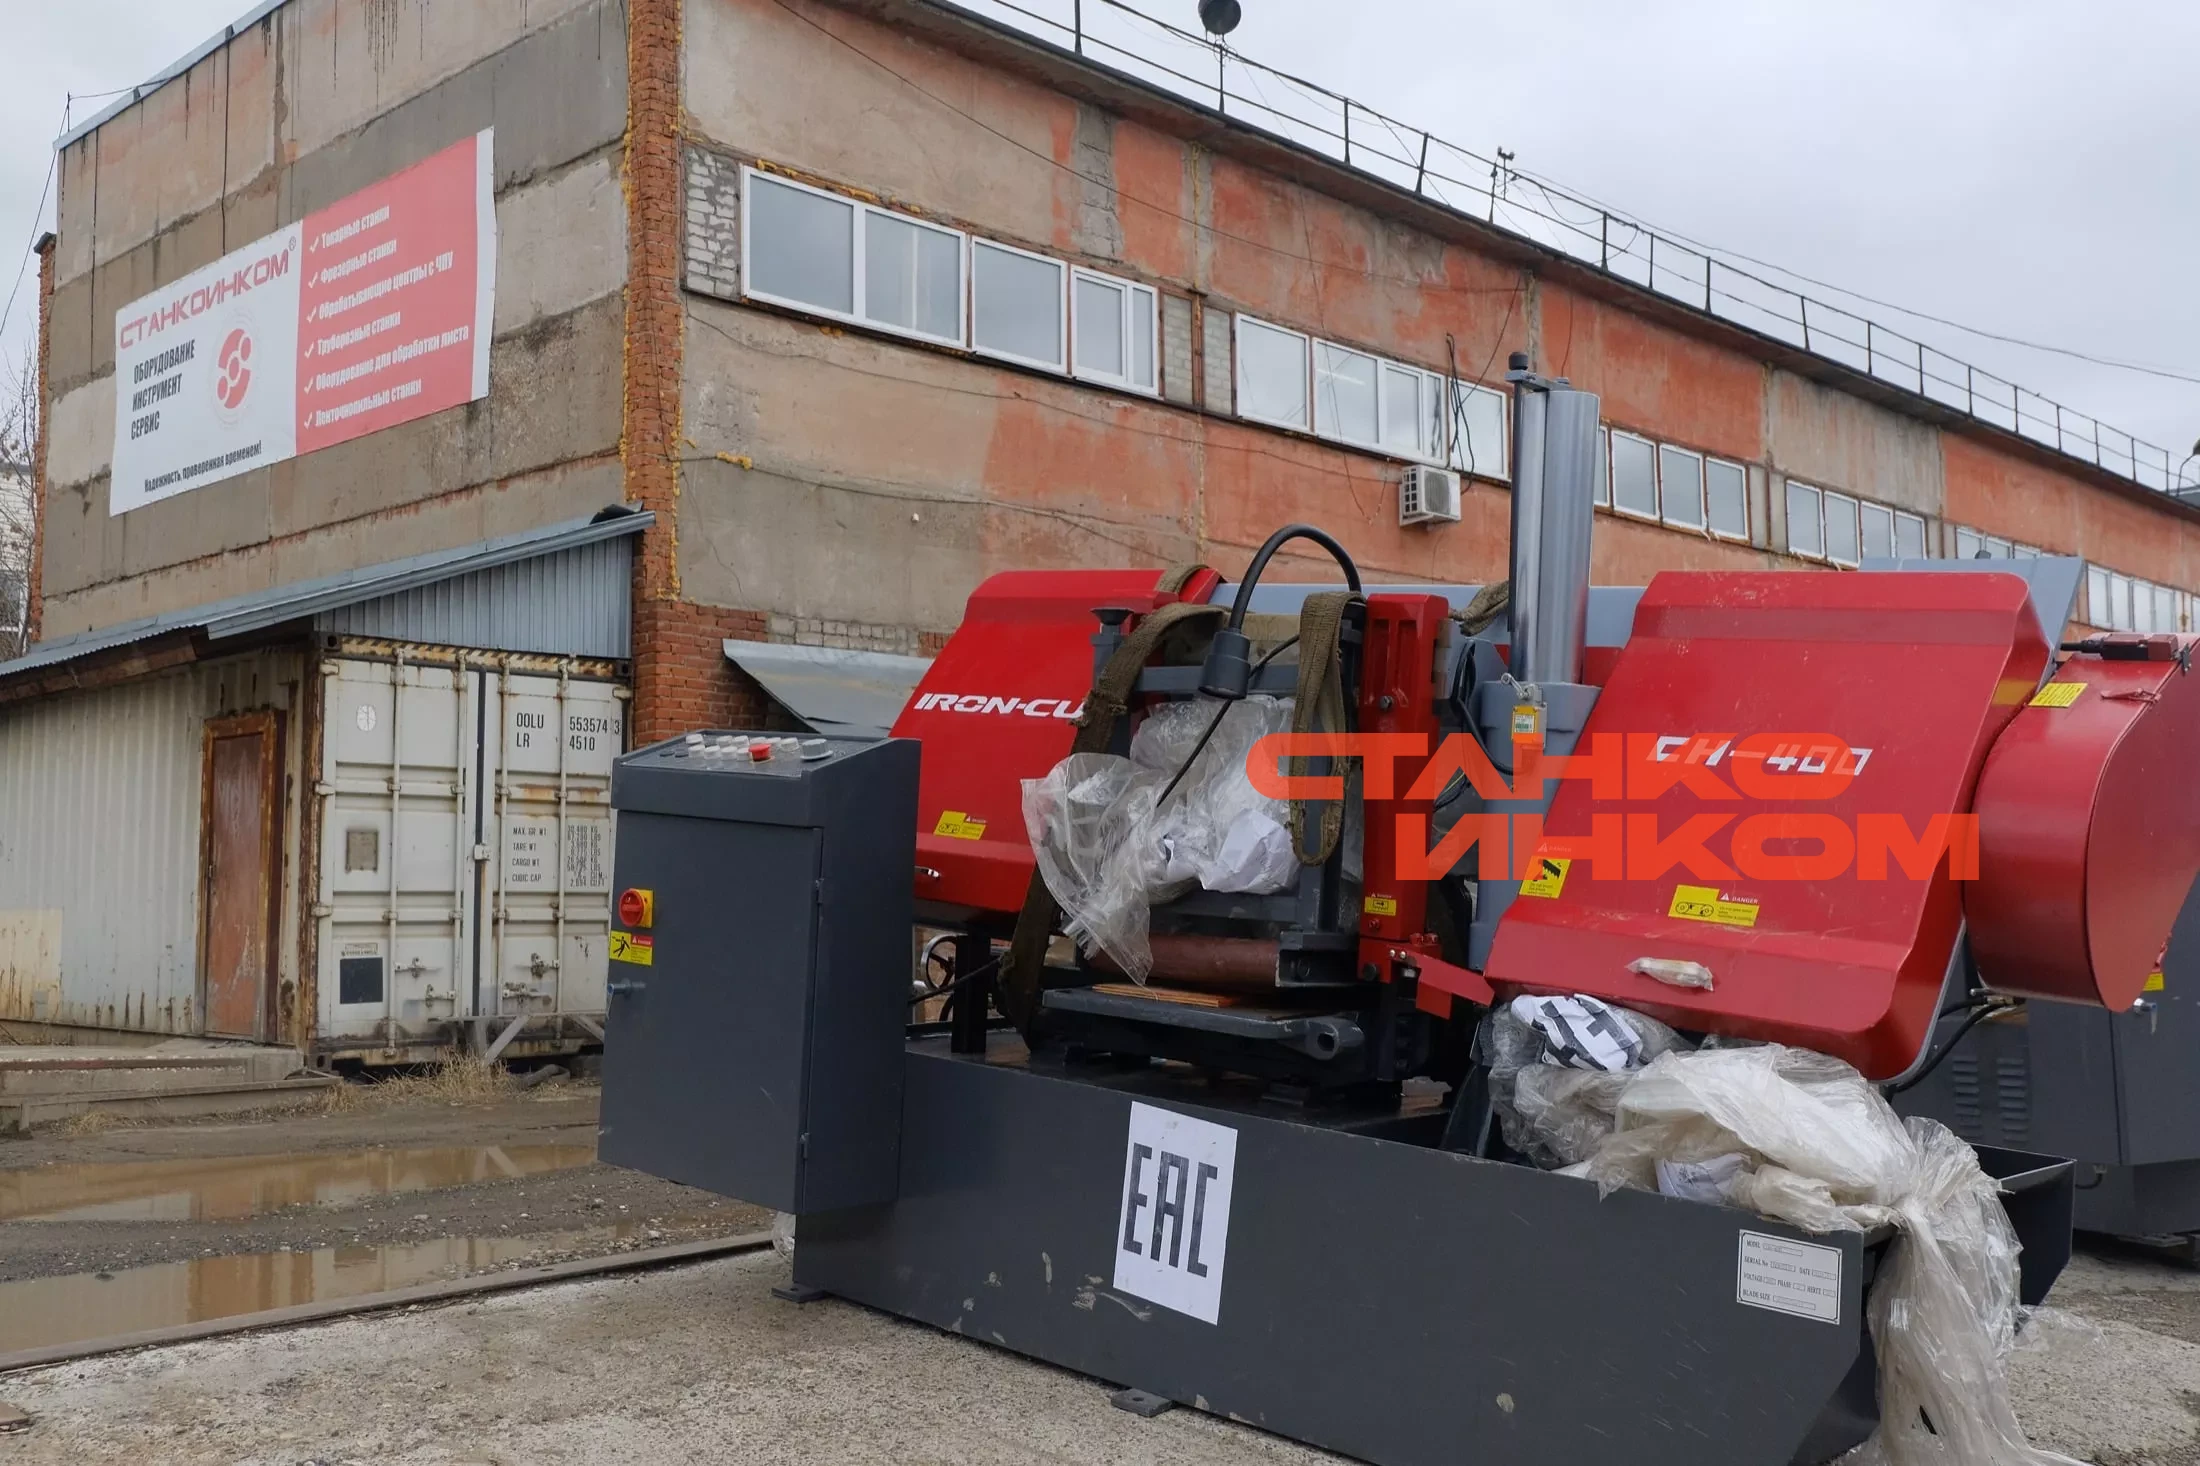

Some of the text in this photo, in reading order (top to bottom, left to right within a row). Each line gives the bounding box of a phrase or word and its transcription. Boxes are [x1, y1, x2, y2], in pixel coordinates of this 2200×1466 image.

[361, 205, 389, 231] станки
[321, 239, 397, 283] Фрезерные станки
[393, 264, 427, 290] центры
[428, 261, 434, 276] с
[436, 251, 454, 272] ЧПУ
[120, 249, 289, 349] СТАНКОИНКОМ
[372, 311, 400, 334] станки
[134, 340, 195, 384] ОБОРУДОВАНИЕ
[316, 325, 469, 391] Оборудование для обработки листа
[133, 373, 182, 412] ИНСТРУМЕНТ
[391, 379, 422, 402] станки
[131, 411, 160, 440] СЕРВИС
[183, 455, 224, 479] проверенная
[225, 440, 262, 466] временем!
[569, 716, 608, 734] 553574
[614, 719, 620, 735] 3
[516, 732, 595, 751] LR 4510
[1746, 1240, 1760, 1249] MODEL
[1744, 1256, 1761, 1265] SERIAL
[1799, 1267, 1810, 1276] DATE
[1743, 1272, 1763, 1283] VOLTAGE
[1777, 1279, 1792, 1288] PHASE
[1742, 1289, 1771, 1301] BLADE SIZE
